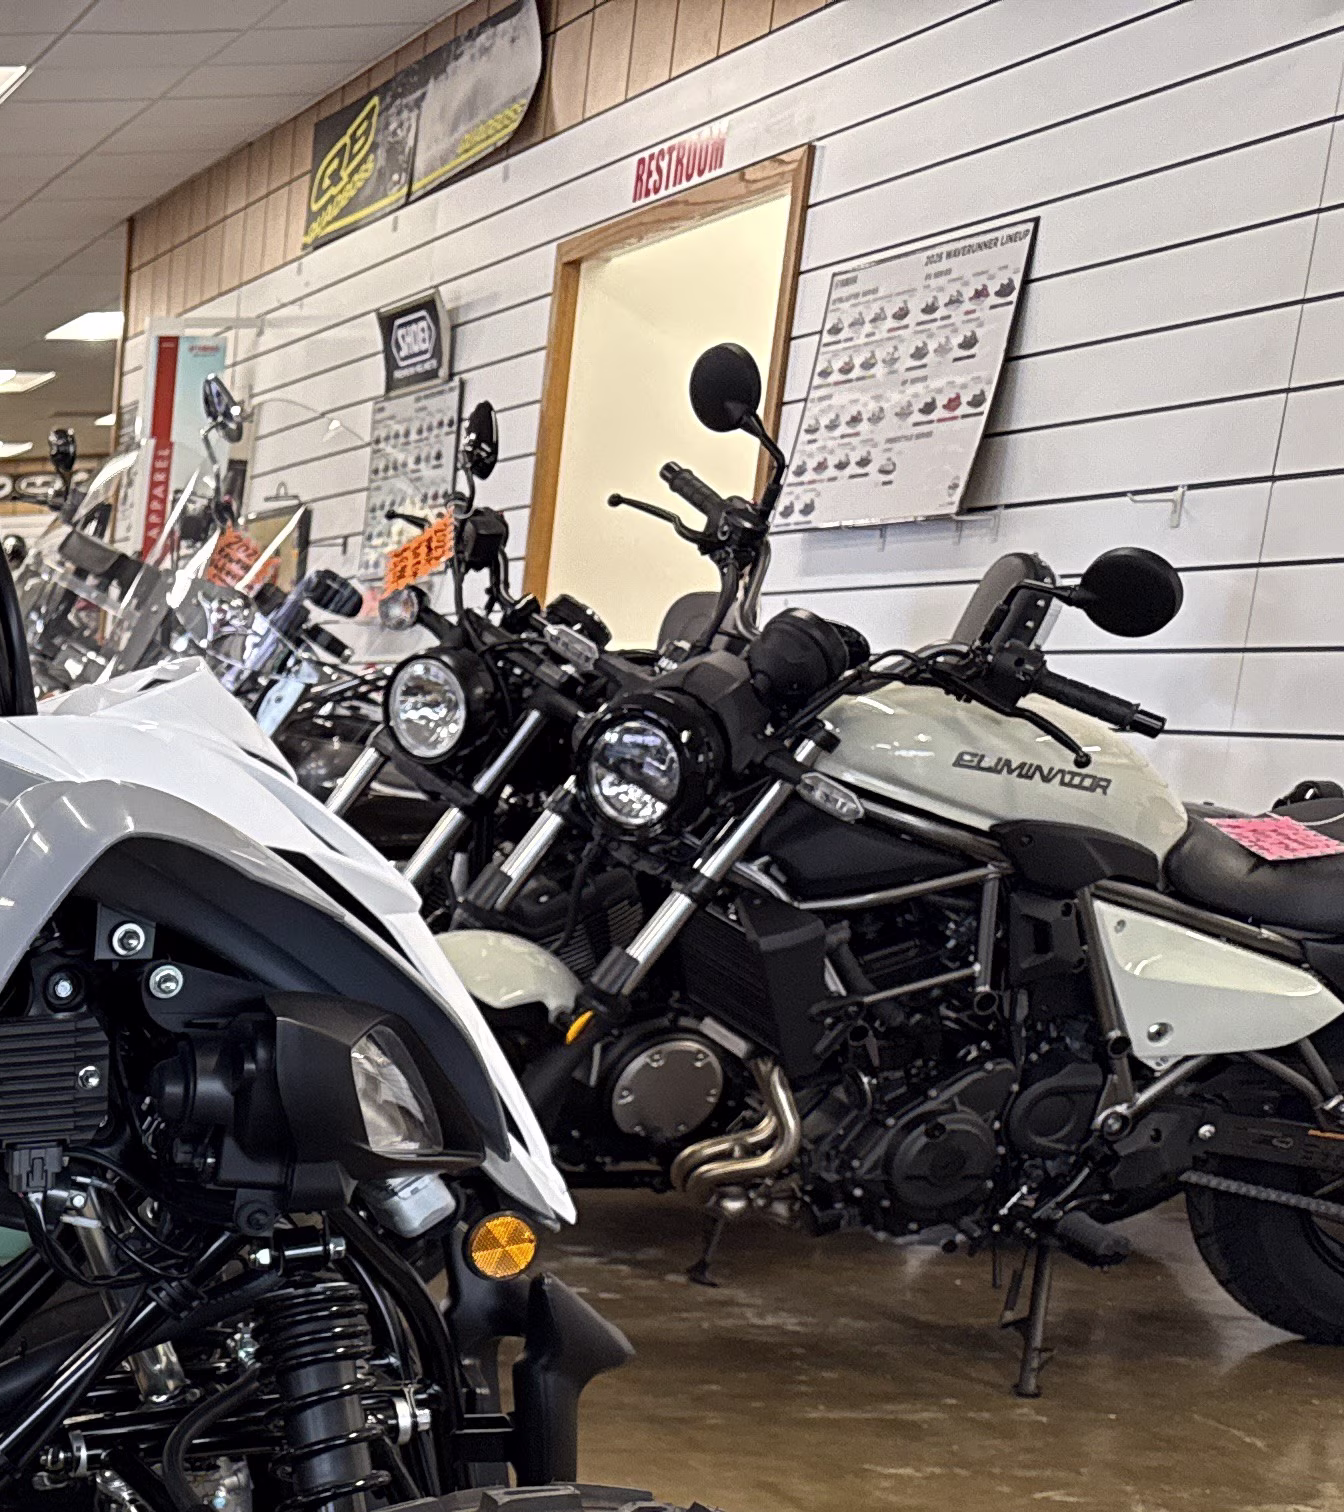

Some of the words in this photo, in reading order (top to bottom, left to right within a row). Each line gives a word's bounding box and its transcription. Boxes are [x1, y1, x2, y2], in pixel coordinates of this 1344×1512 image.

[632, 137, 726, 203] RESTROOM
[147, 448, 170, 541] APPAREL
[952, 750, 1112, 796] ELIMINATOR
